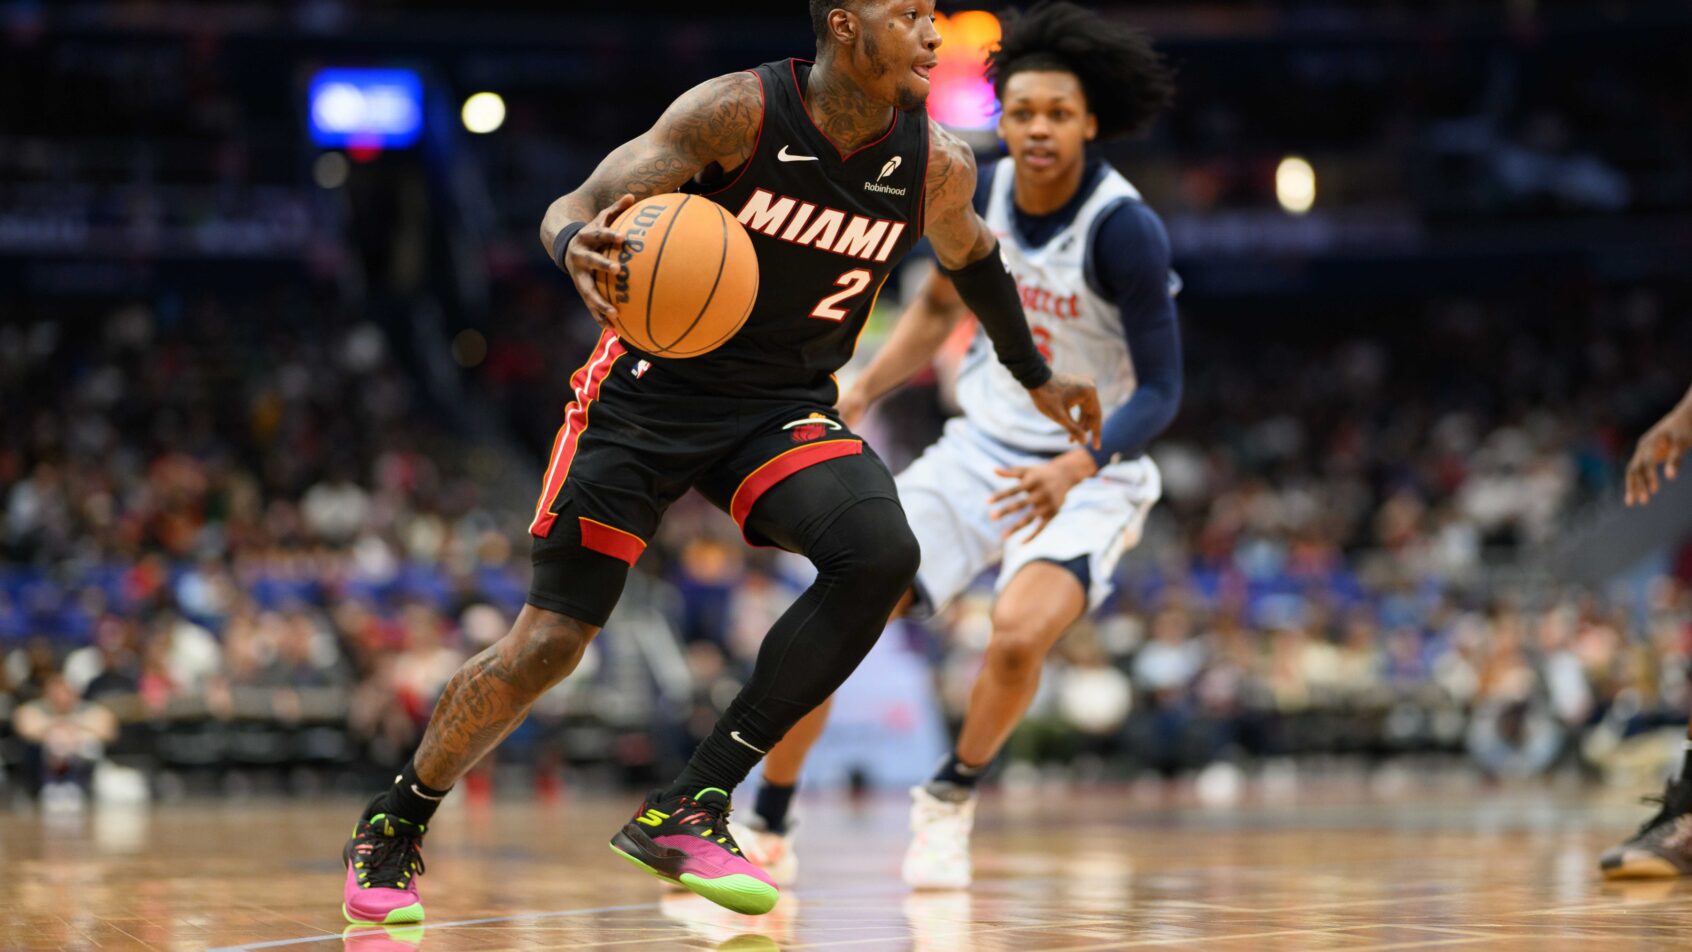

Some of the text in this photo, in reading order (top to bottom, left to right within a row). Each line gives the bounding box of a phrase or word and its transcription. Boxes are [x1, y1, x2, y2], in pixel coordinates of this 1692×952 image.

[864, 181, 906, 196] Robinhood
[615, 204, 668, 304] Wilson
[736, 187, 907, 263] MIAMI
[808, 267, 873, 321] 2
